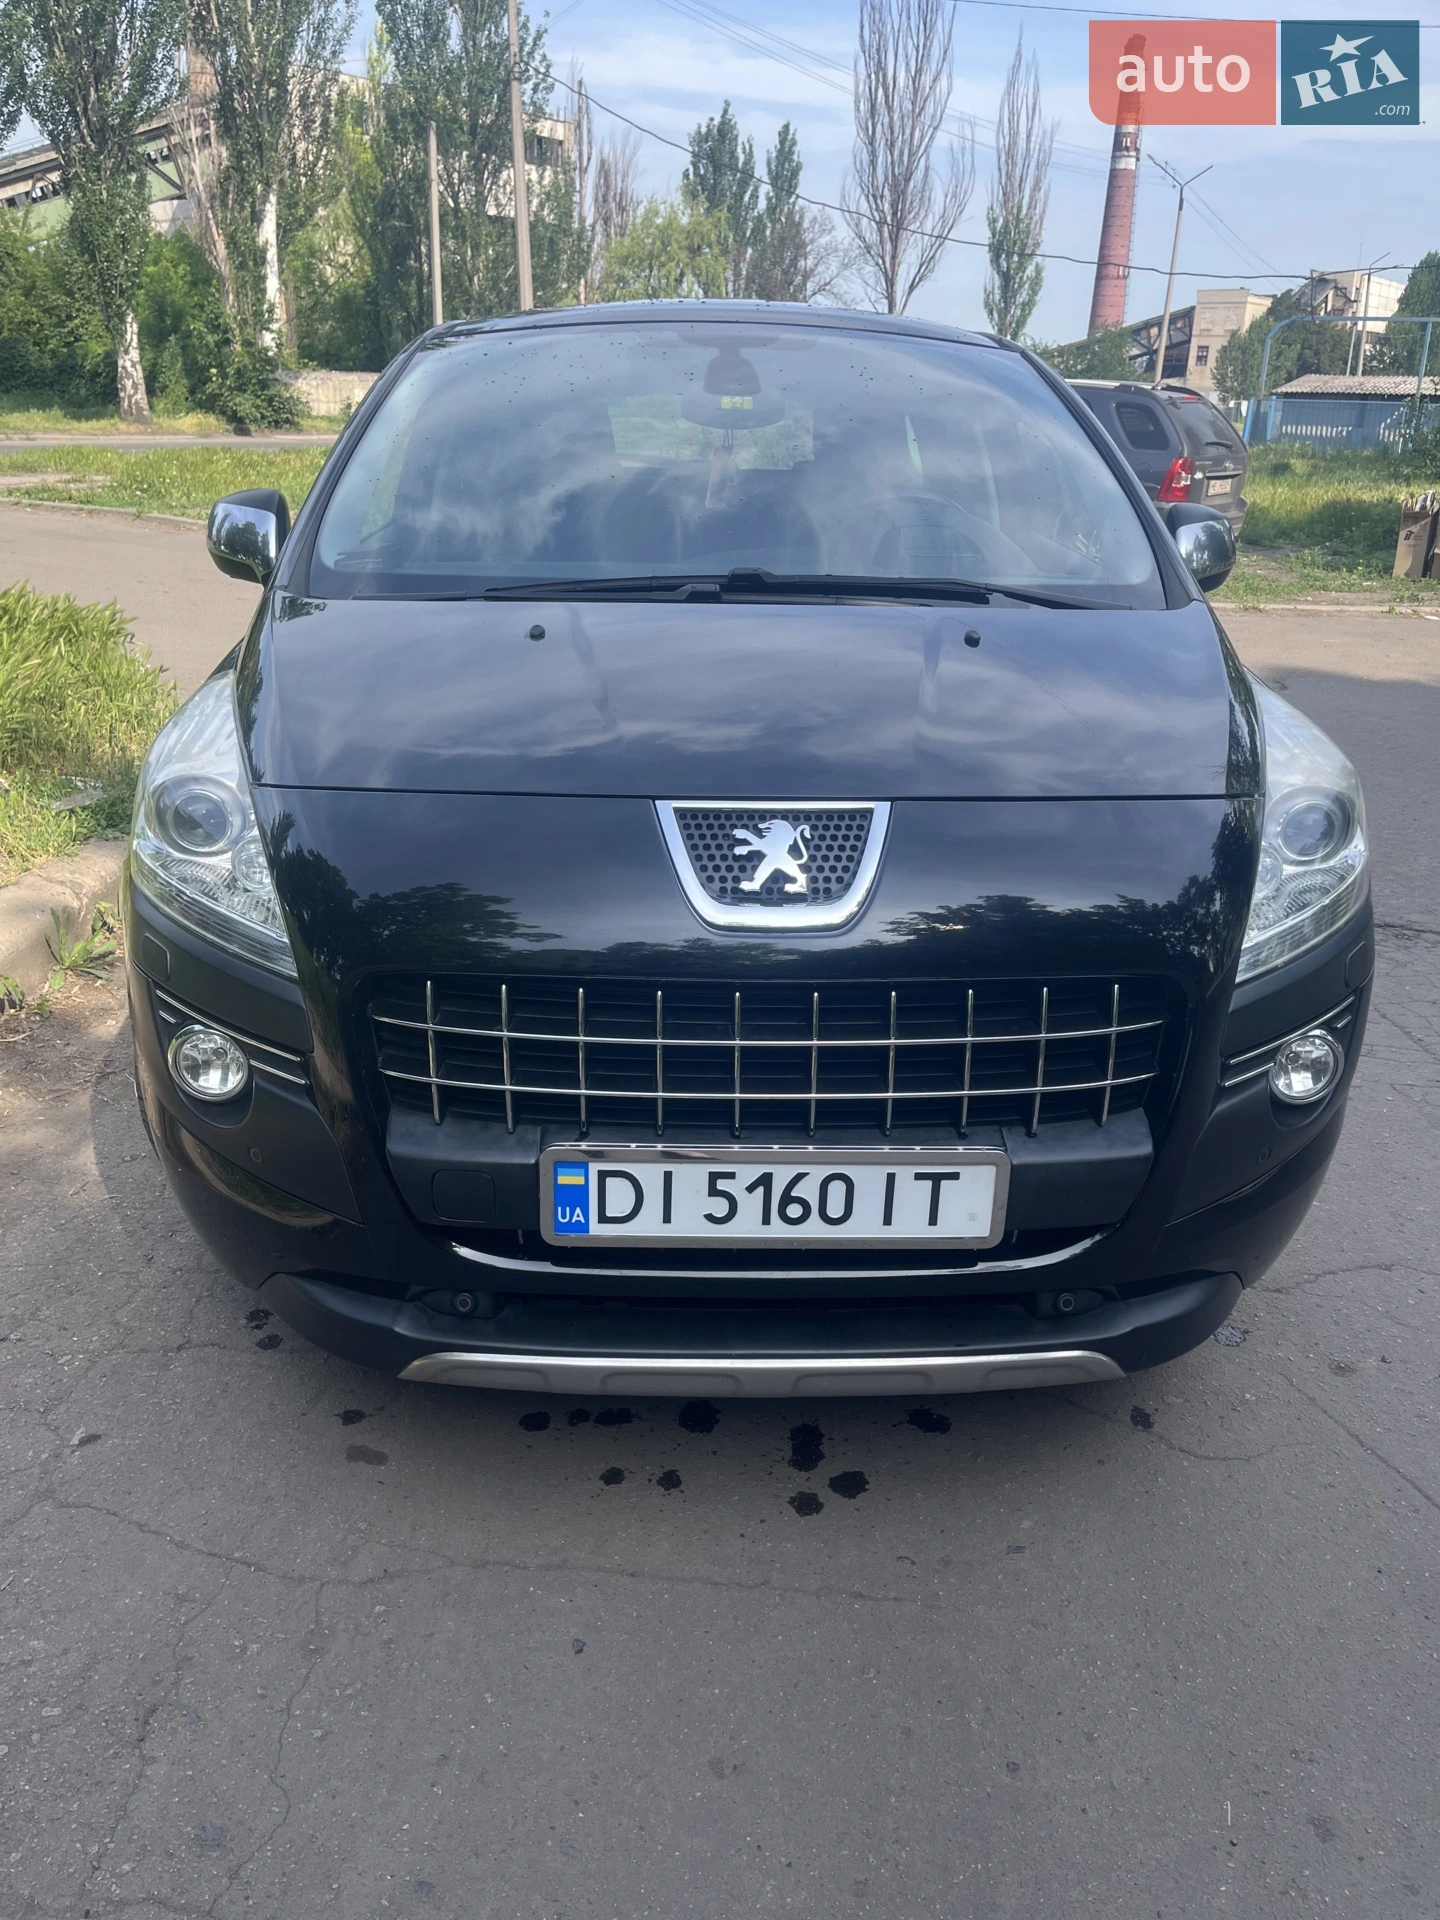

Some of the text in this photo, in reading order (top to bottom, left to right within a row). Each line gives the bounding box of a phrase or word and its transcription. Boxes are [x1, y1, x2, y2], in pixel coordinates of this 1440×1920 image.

[557, 1206, 586, 1224] UA
[597, 1169, 961, 1227] DI 5160 IT
